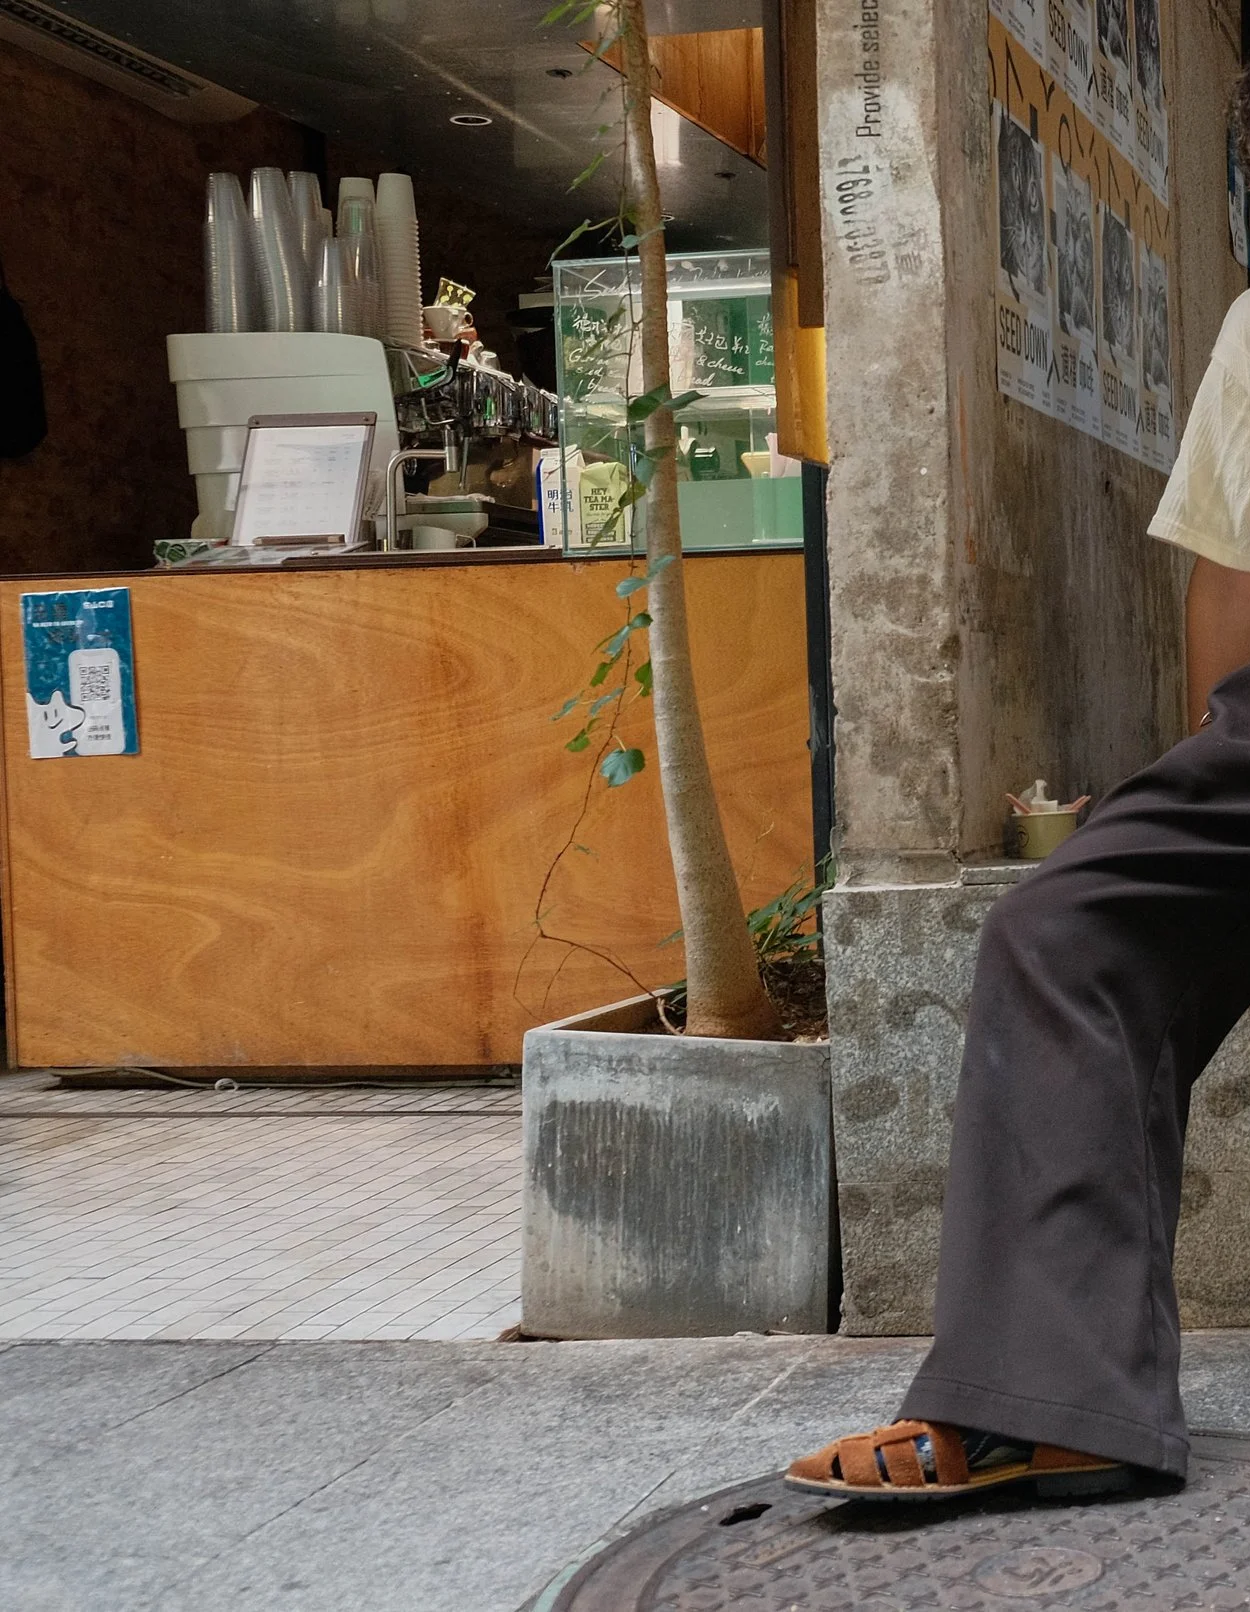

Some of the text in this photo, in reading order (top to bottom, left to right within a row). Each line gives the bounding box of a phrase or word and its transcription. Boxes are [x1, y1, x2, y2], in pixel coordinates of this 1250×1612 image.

[855, 60, 881, 137] Provide
[1000, 304, 1048, 372] SEED DOWN
[591, 487, 608, 496] HEY
[584, 495, 599, 503] TEA
[589, 503, 610, 511] STER
